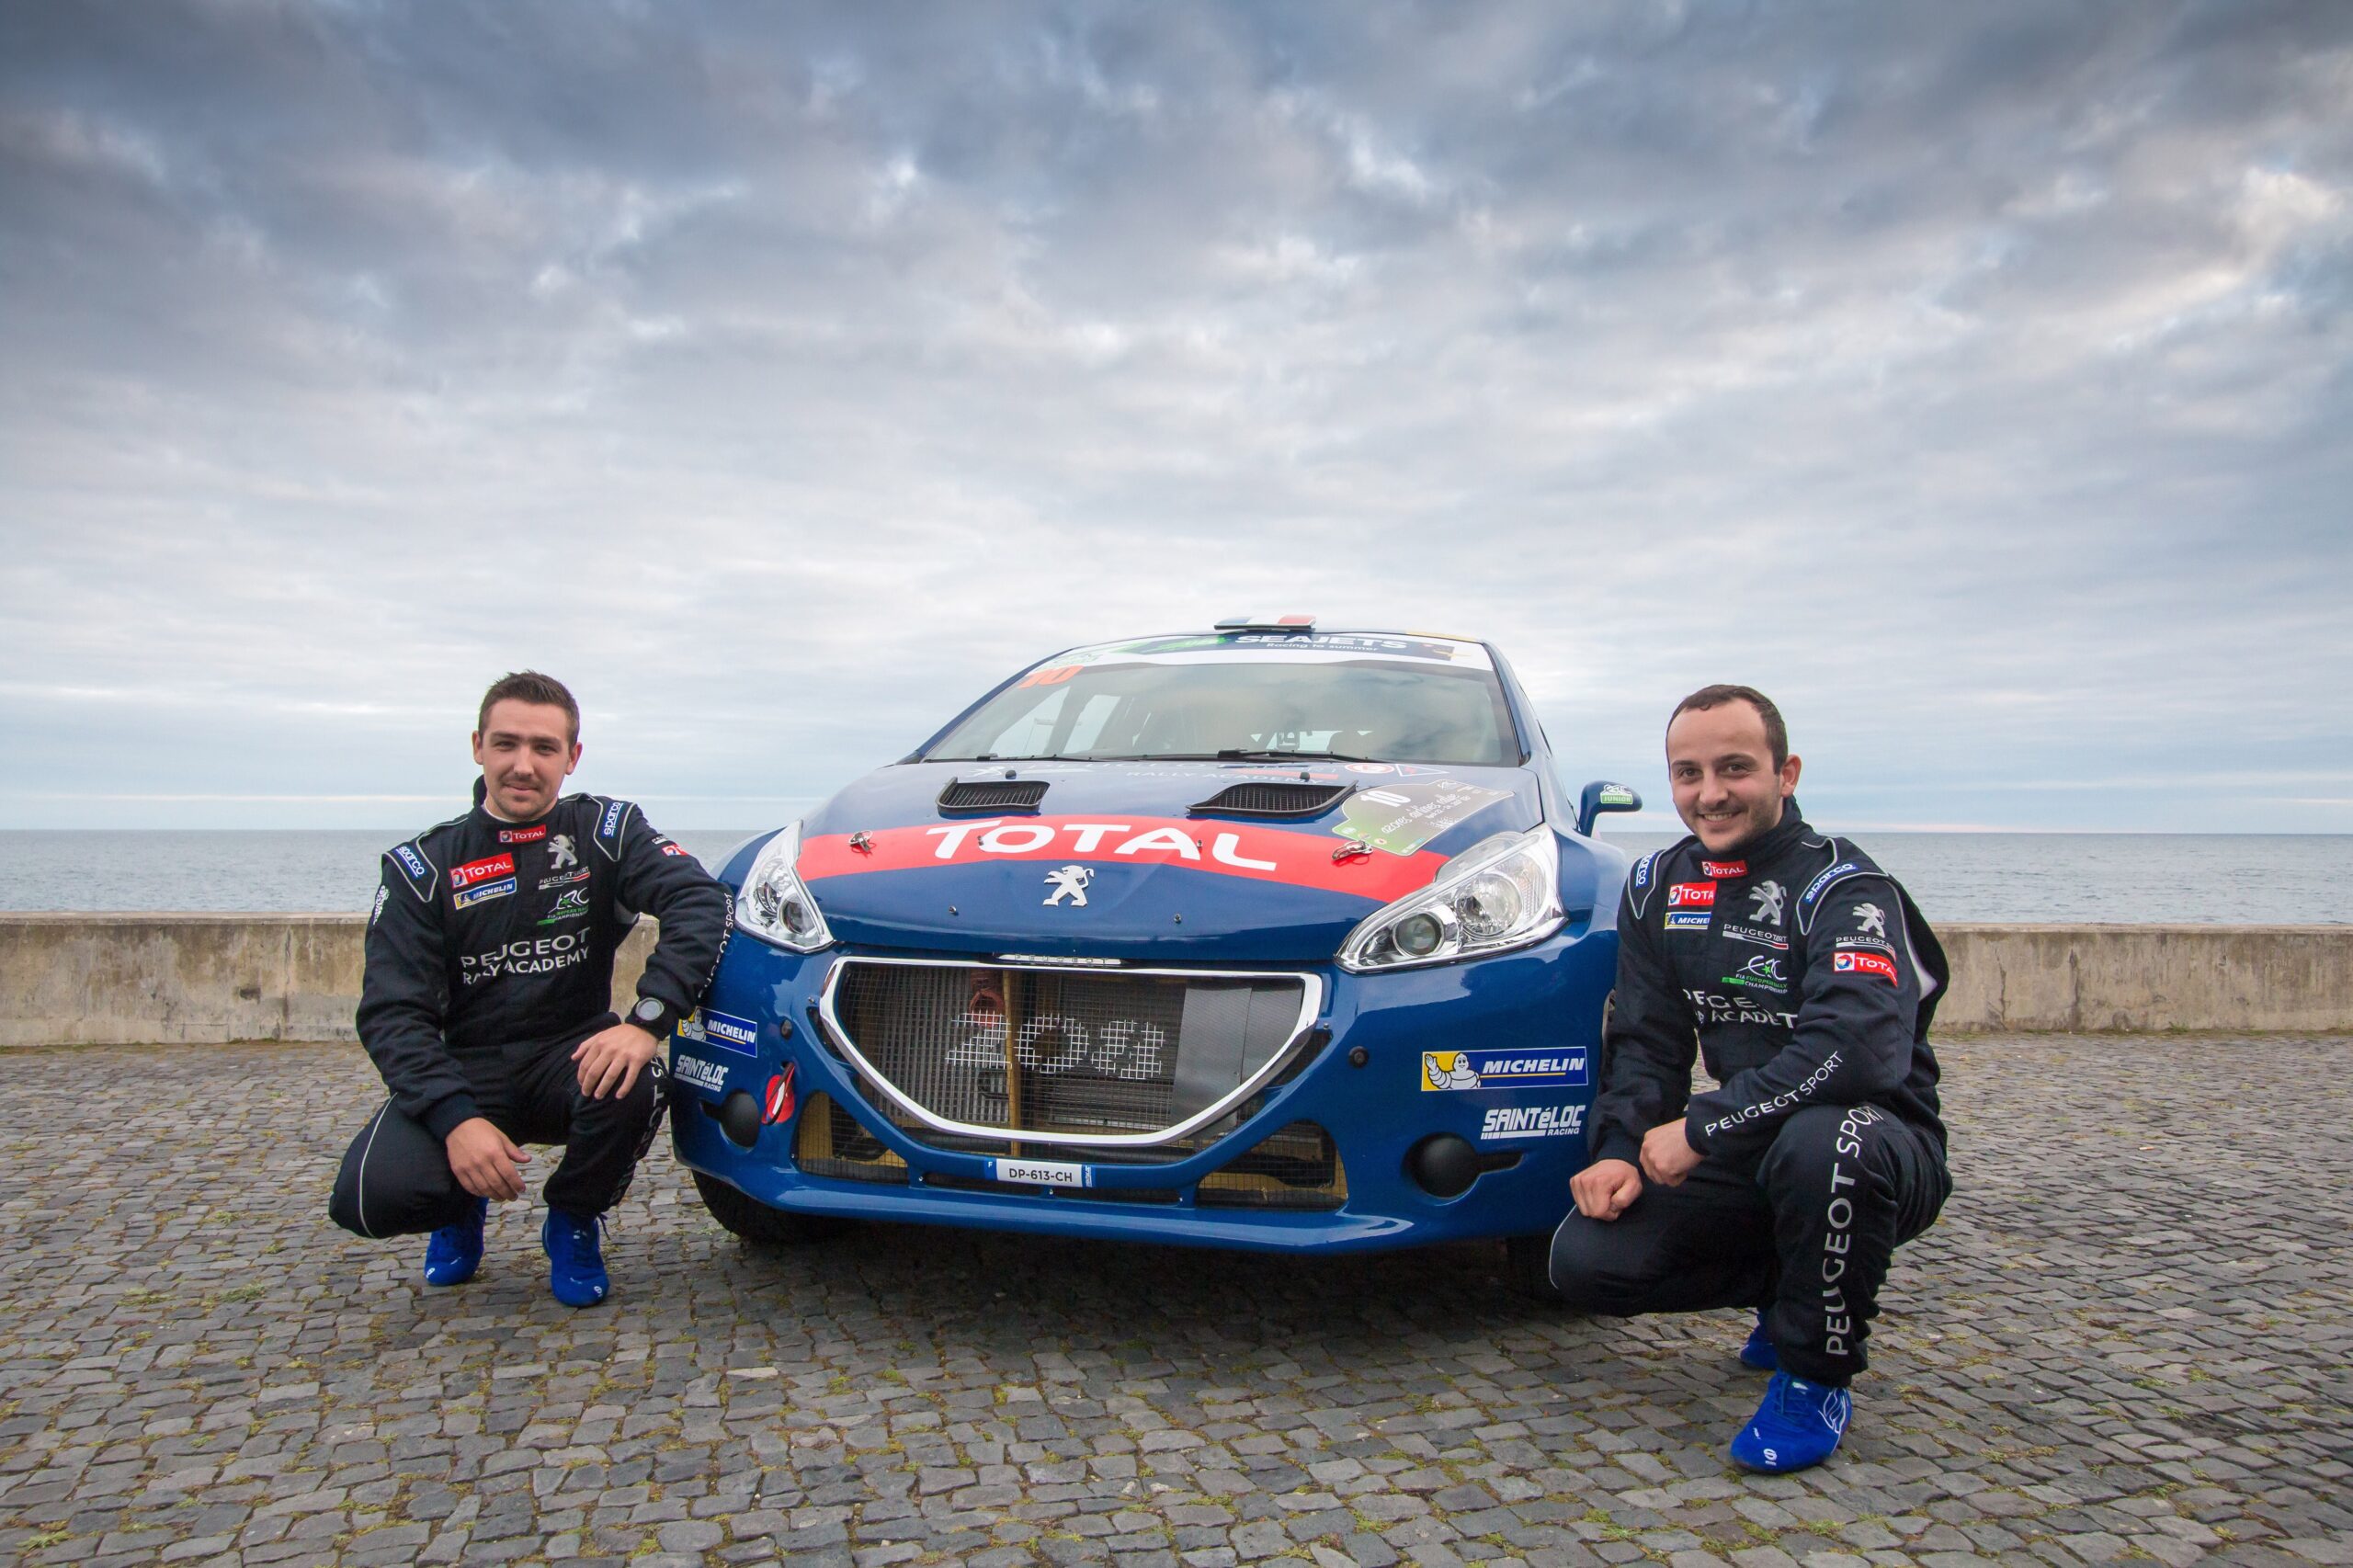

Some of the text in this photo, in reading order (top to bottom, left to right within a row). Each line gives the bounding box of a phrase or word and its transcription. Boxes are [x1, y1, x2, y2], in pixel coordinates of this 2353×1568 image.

[1235, 634, 1408, 649] SEAJETS
[1267, 642, 1309, 651] Racing
[1017, 665, 1085, 689] 10
[1360, 790, 1411, 807] 10
[604, 801, 622, 835] sparco
[513, 830, 545, 840] TOTAL
[926, 819, 1278, 872] TOTAL
[464, 861, 512, 878] TOTAL
[1712, 866, 1745, 875] TOTAL
[1805, 863, 1855, 902] sparco
[472, 883, 513, 900] MICHELIN
[504, 946, 590, 974] ACADEMY
[707, 1019, 756, 1044] MICHELIN
[946, 1009, 1165, 1080] 208
[1482, 1057, 1586, 1074] MICHELIN
[703, 1081, 722, 1093] RACING
[1704, 1051, 1844, 1137] PEUGEOT SPORT
[1482, 1104, 1586, 1132] SAINTéLOC
[1547, 1126, 1580, 1137] RACING
[1008, 1167, 1073, 1183] DP-613-CH
[1822, 1163, 1856, 1357] PEUGEOT
